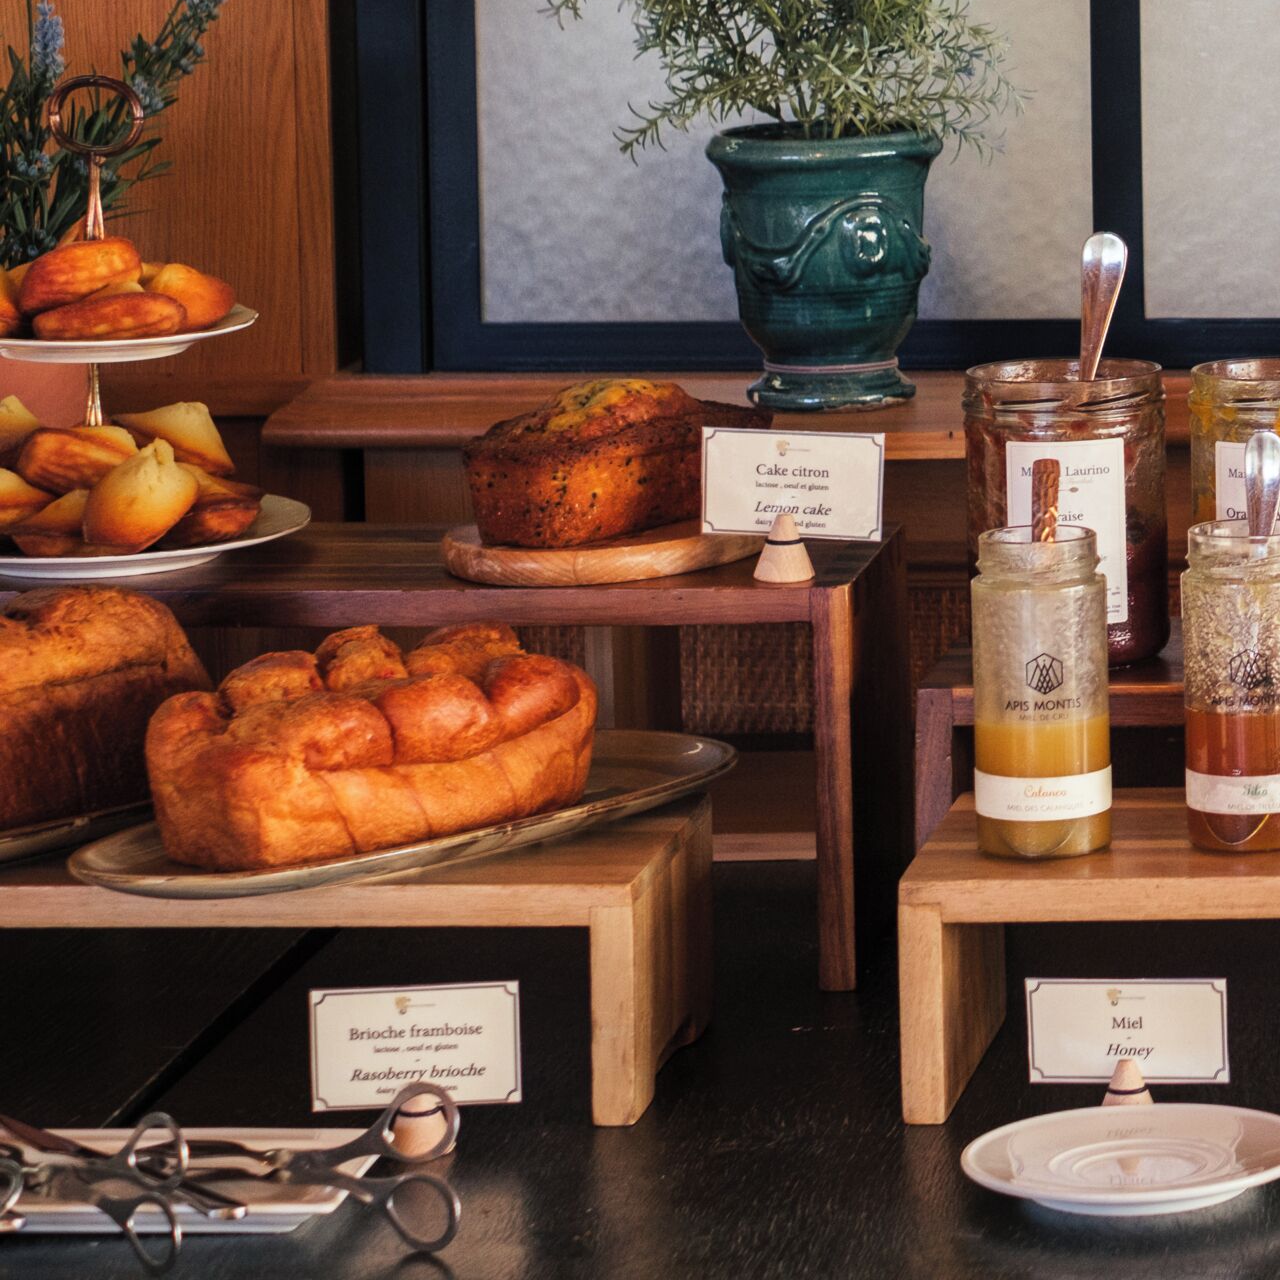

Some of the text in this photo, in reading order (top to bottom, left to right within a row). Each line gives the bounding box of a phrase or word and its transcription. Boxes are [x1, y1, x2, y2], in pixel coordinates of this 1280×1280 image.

[756, 463, 829, 478] Cake citron
[1065, 466, 1110, 477] Laurino
[754, 501, 832, 516] Lemon cake
[1057, 511, 1084, 521] raise
[1005, 697, 1081, 711] APIS MONTIS
[1112, 1017, 1142, 1029] Miel
[349, 1023, 483, 1040] Brioche framboise
[1106, 1043, 1154, 1060] Honey
[430, 1063, 486, 1078] brioche
